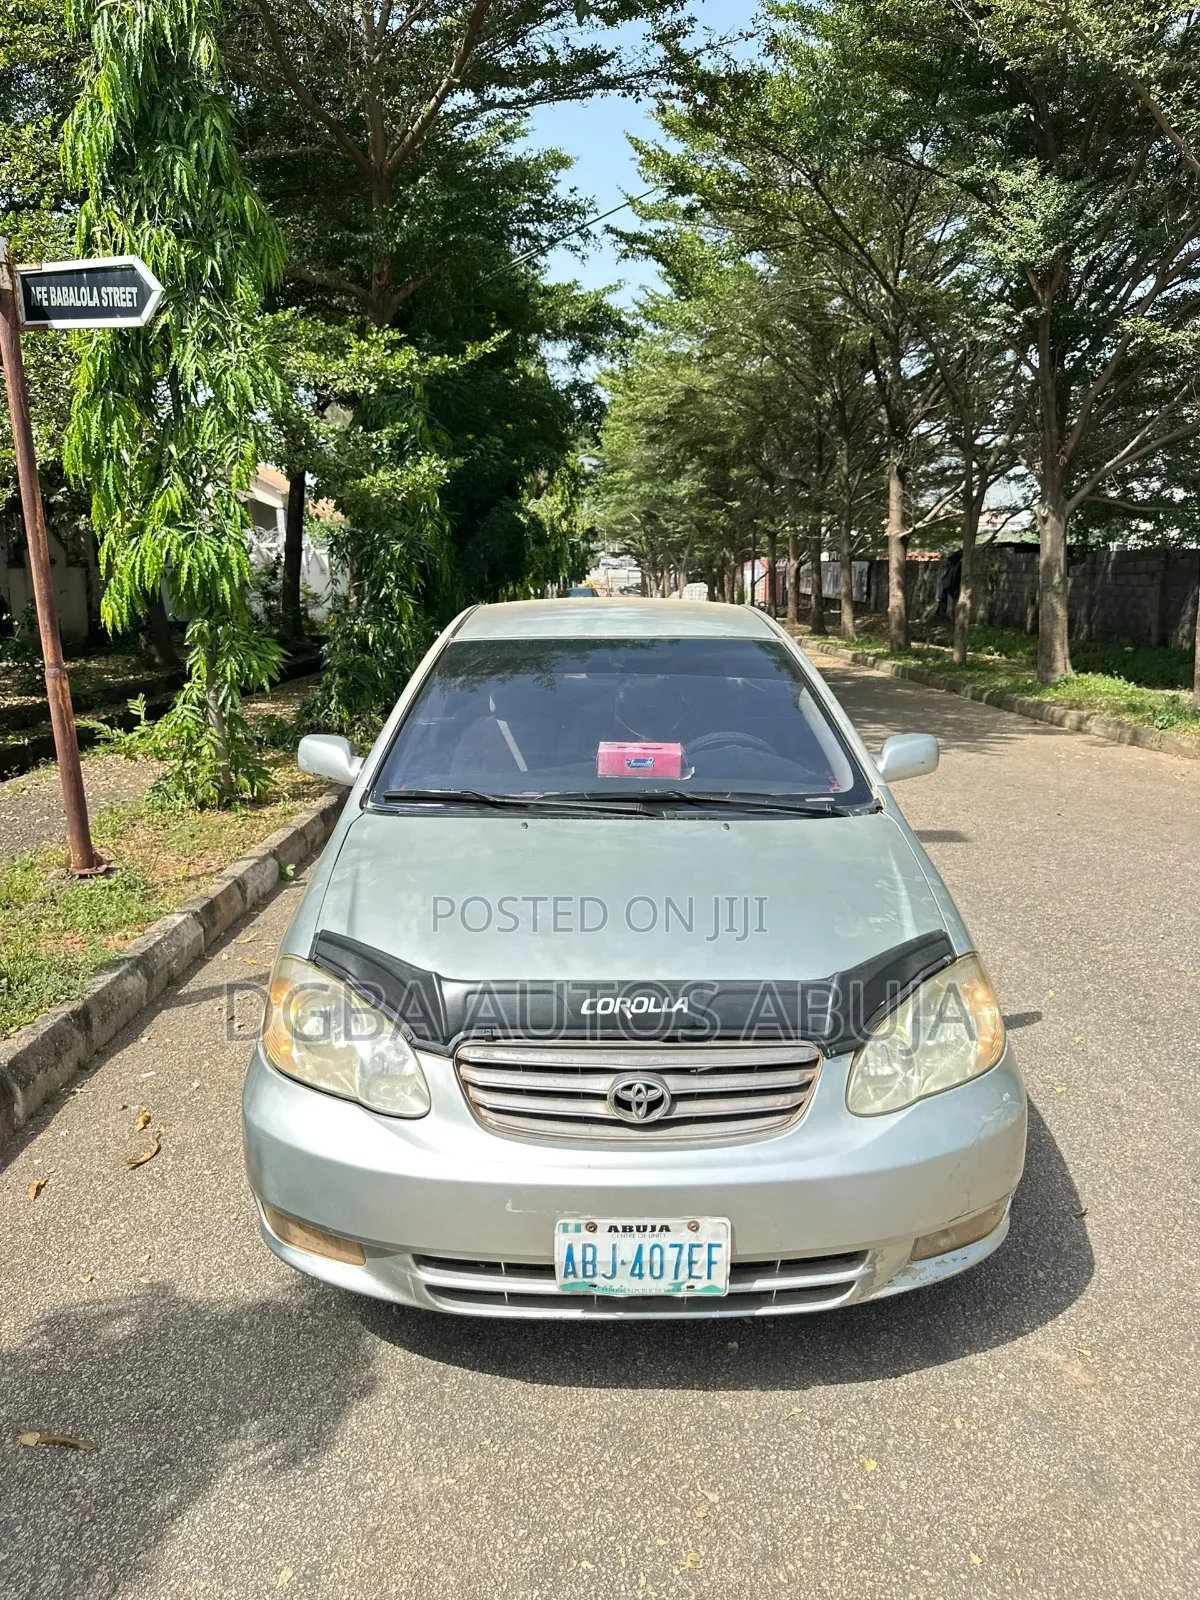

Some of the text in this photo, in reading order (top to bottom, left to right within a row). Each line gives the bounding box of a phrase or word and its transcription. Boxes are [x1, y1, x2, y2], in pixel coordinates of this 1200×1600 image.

[31, 286, 138, 307] AFE BABALOLA STREET
[580, 996, 689, 1019] COROLLA
[607, 1224, 672, 1233] ABUJA
